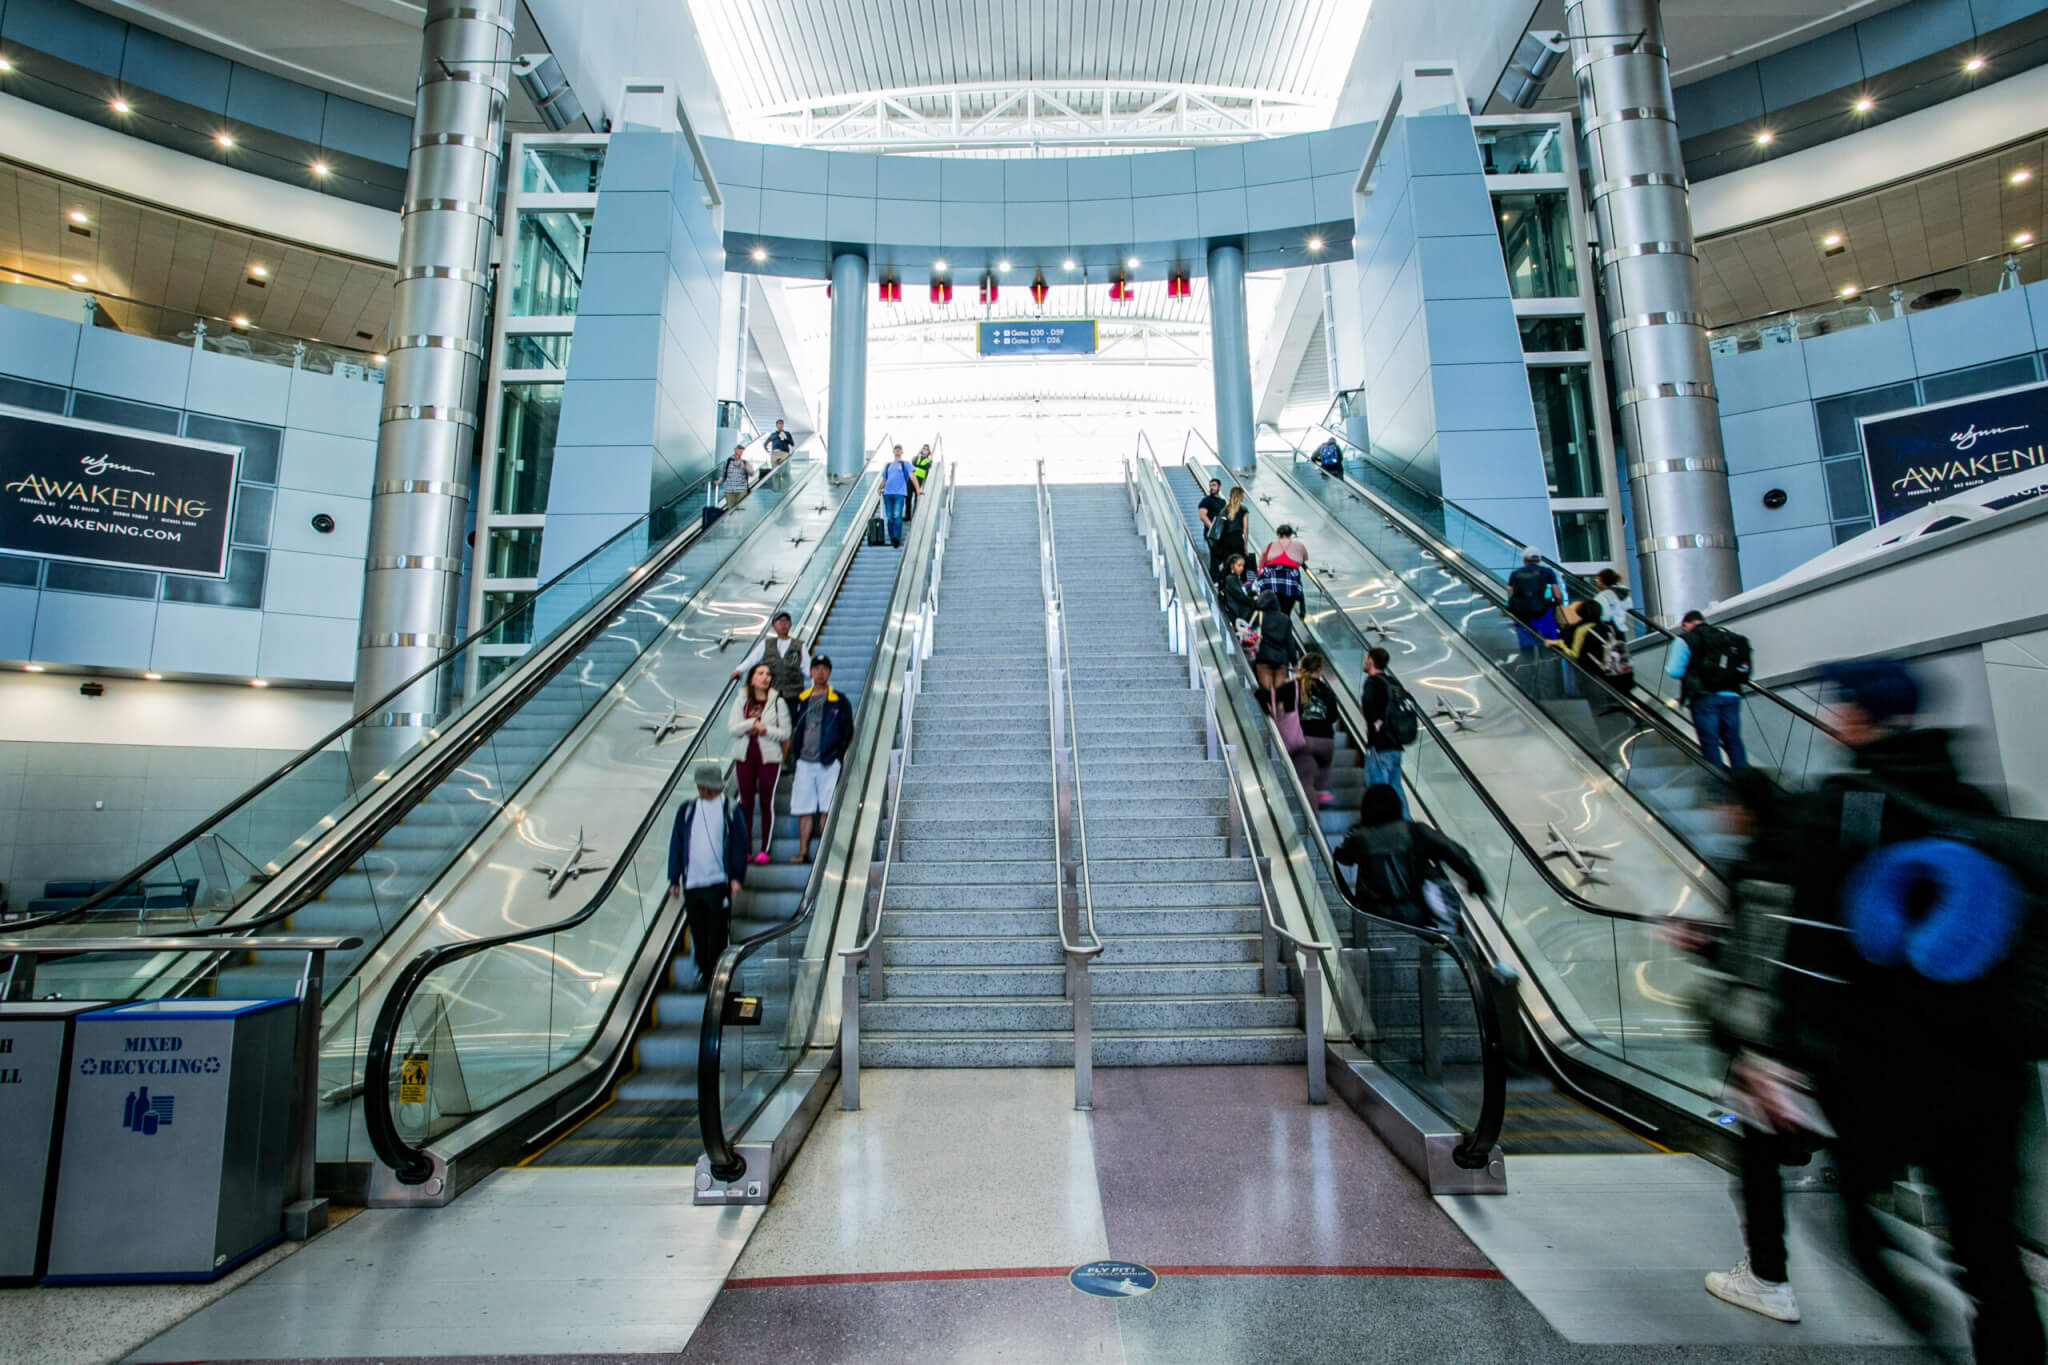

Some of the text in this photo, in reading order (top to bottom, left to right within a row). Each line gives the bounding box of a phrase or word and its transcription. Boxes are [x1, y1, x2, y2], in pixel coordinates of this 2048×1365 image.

[1950, 424, 2029, 450] wynn
[80, 453, 155, 475] wynn
[1892, 445, 2048, 491] AWAKENI
[5, 473, 212, 518] AWAKENING
[32, 513, 183, 542] AWAKENING.COM
[124, 1037, 183, 1052] MIXED
[98, 1058, 203, 1075] RECYCLING
